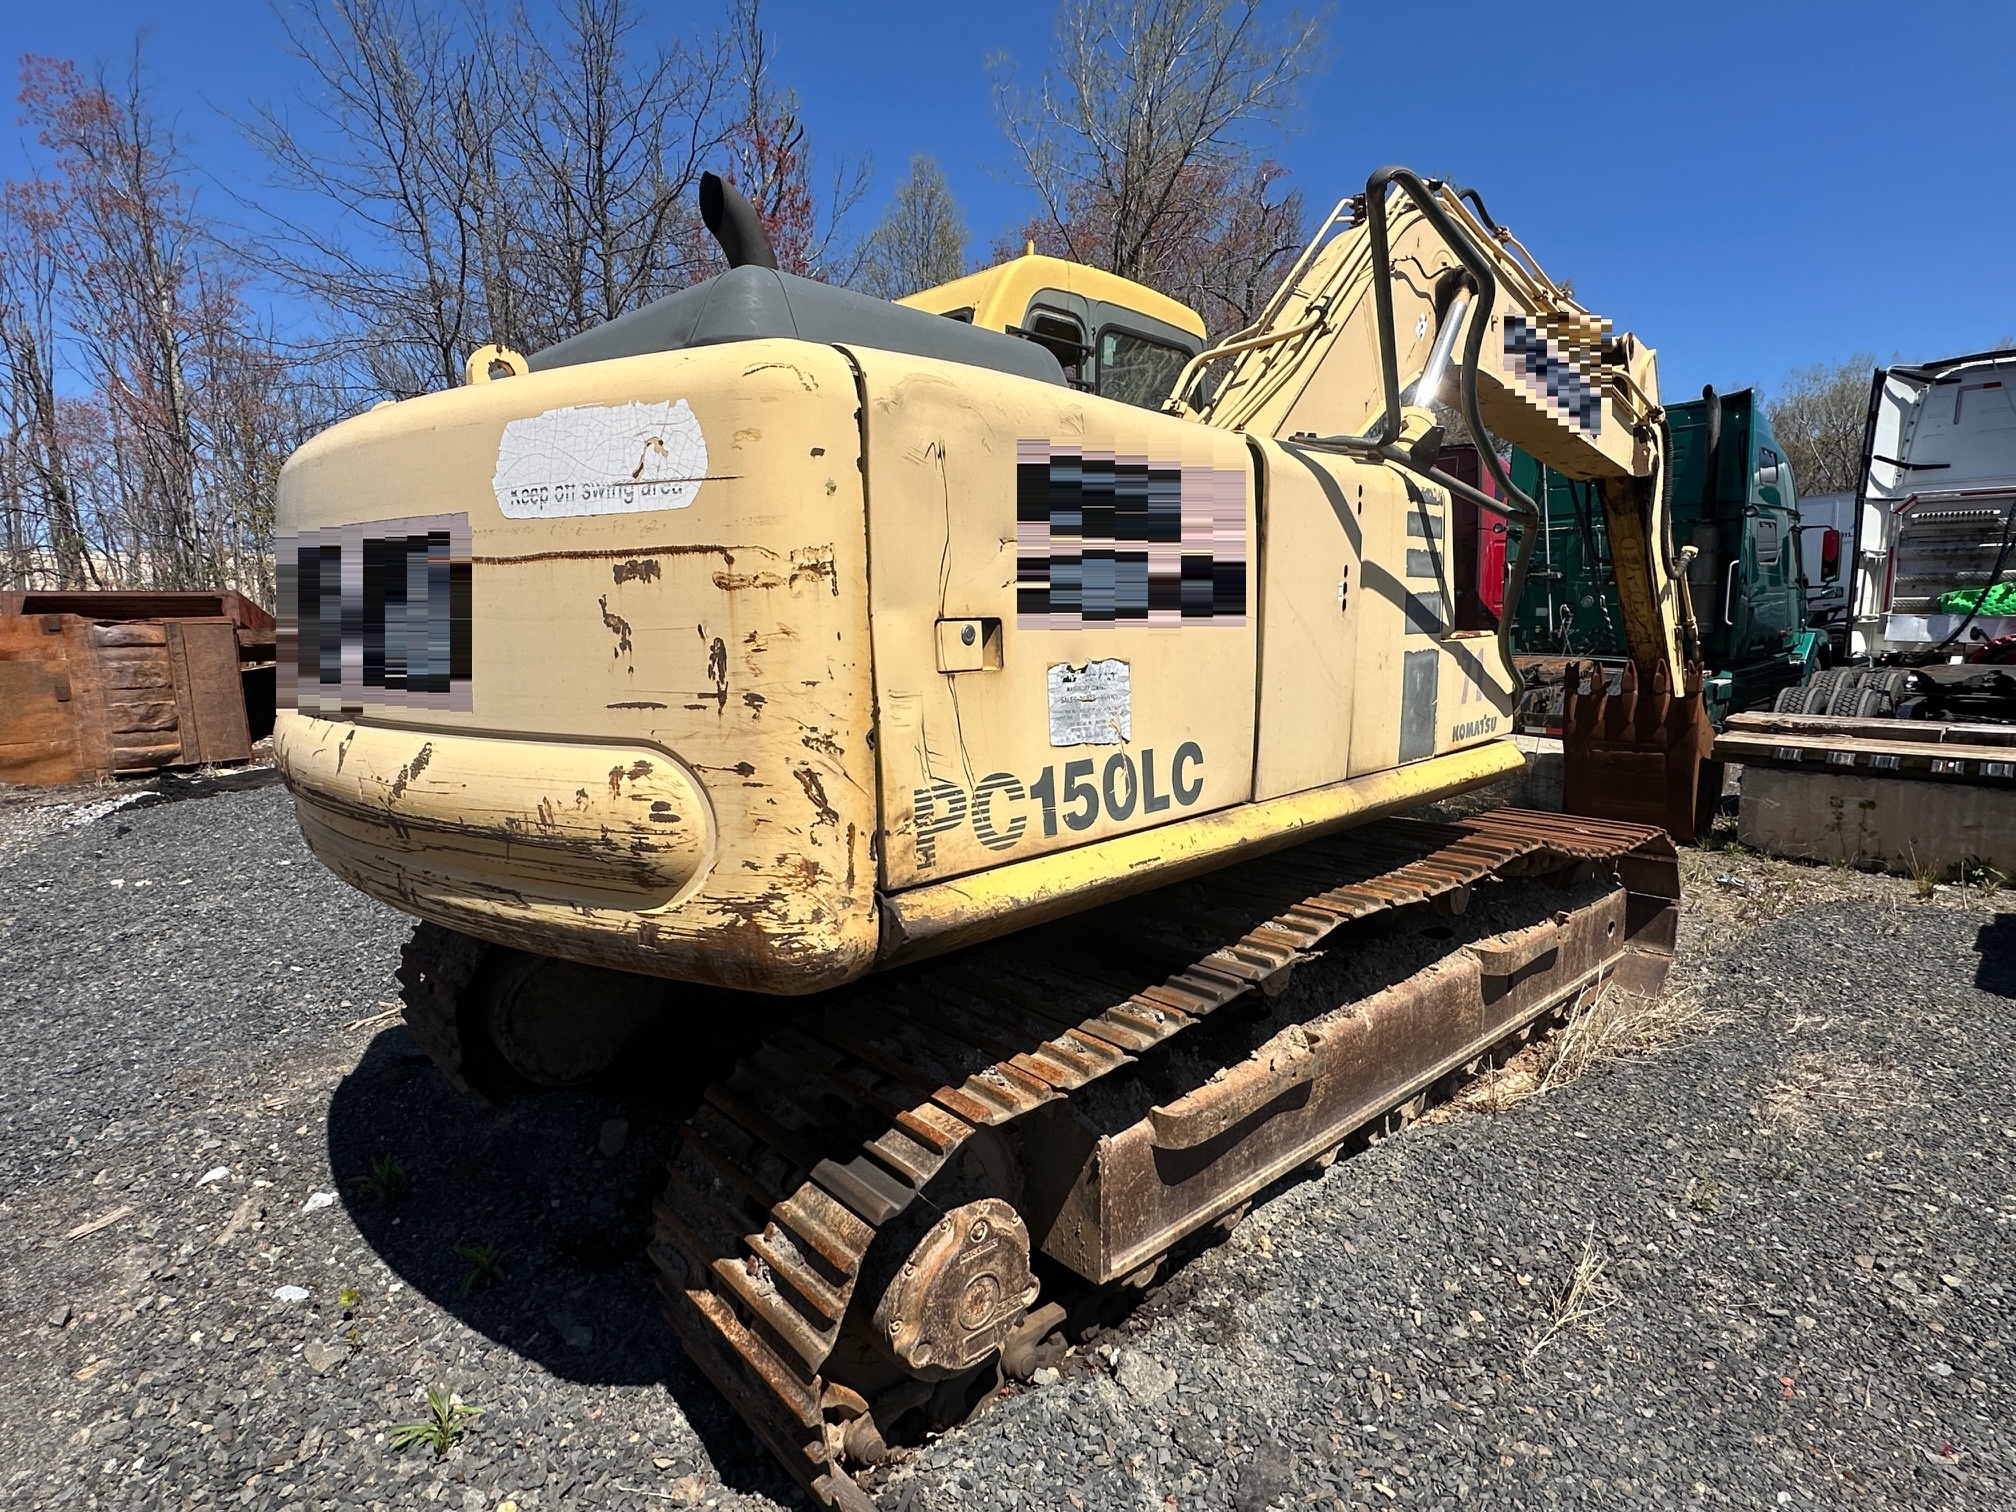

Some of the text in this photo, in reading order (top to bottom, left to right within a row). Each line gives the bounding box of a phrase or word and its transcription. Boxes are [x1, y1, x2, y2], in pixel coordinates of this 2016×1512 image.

[511, 486, 548, 510] Keep
[1452, 714, 1497, 742] KOMATSU
[913, 741, 1204, 870] PC150LC
